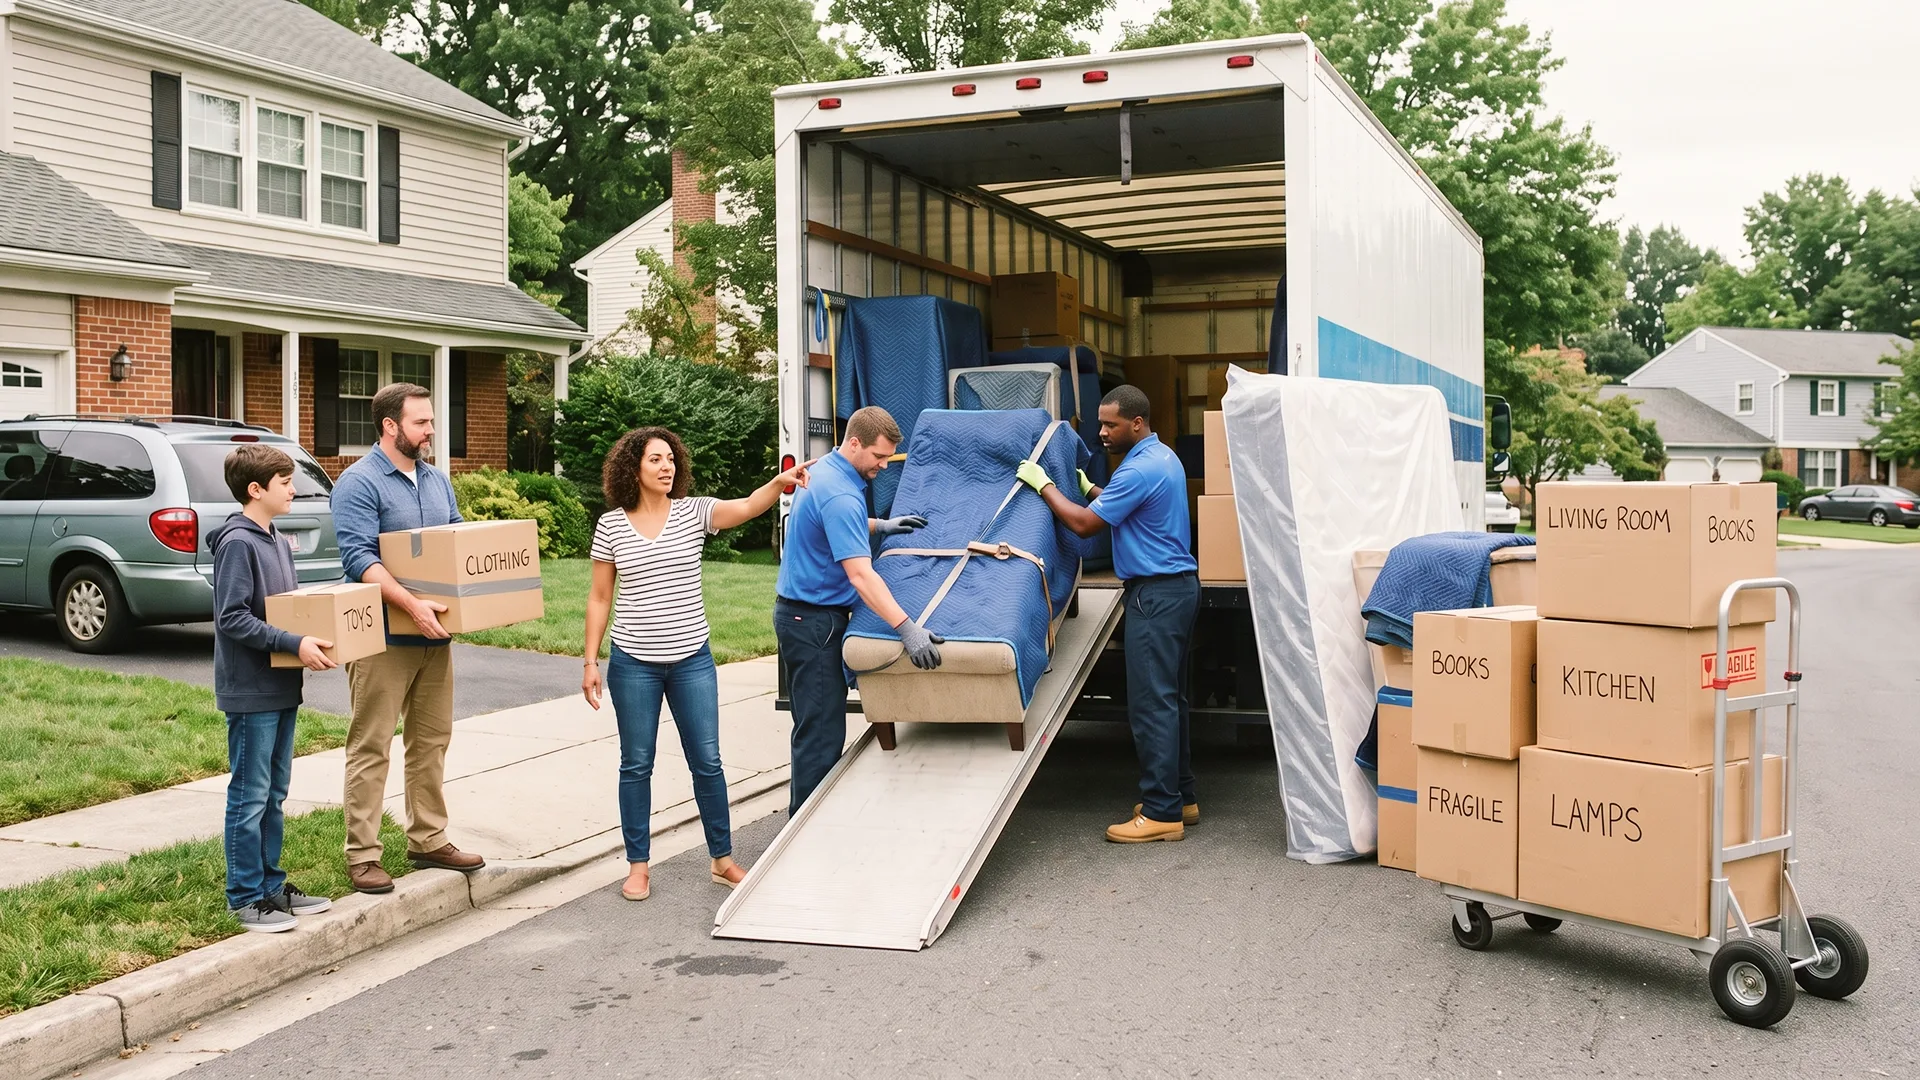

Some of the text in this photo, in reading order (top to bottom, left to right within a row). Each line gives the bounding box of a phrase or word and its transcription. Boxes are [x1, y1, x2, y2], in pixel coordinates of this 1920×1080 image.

[1549, 505, 1671, 533] LIVING ROOM
[1708, 515, 1755, 544] BOOKS
[466, 547, 530, 576] CLOTHING
[343, 605, 373, 632] TOYS
[1432, 649, 1490, 680] BOOKS
[1727, 653, 1755, 674] AGILE
[1562, 665, 1655, 704] KITCHEN
[1428, 785, 1504, 824] FRAGILE
[1551, 793, 1643, 843] LAMPS
